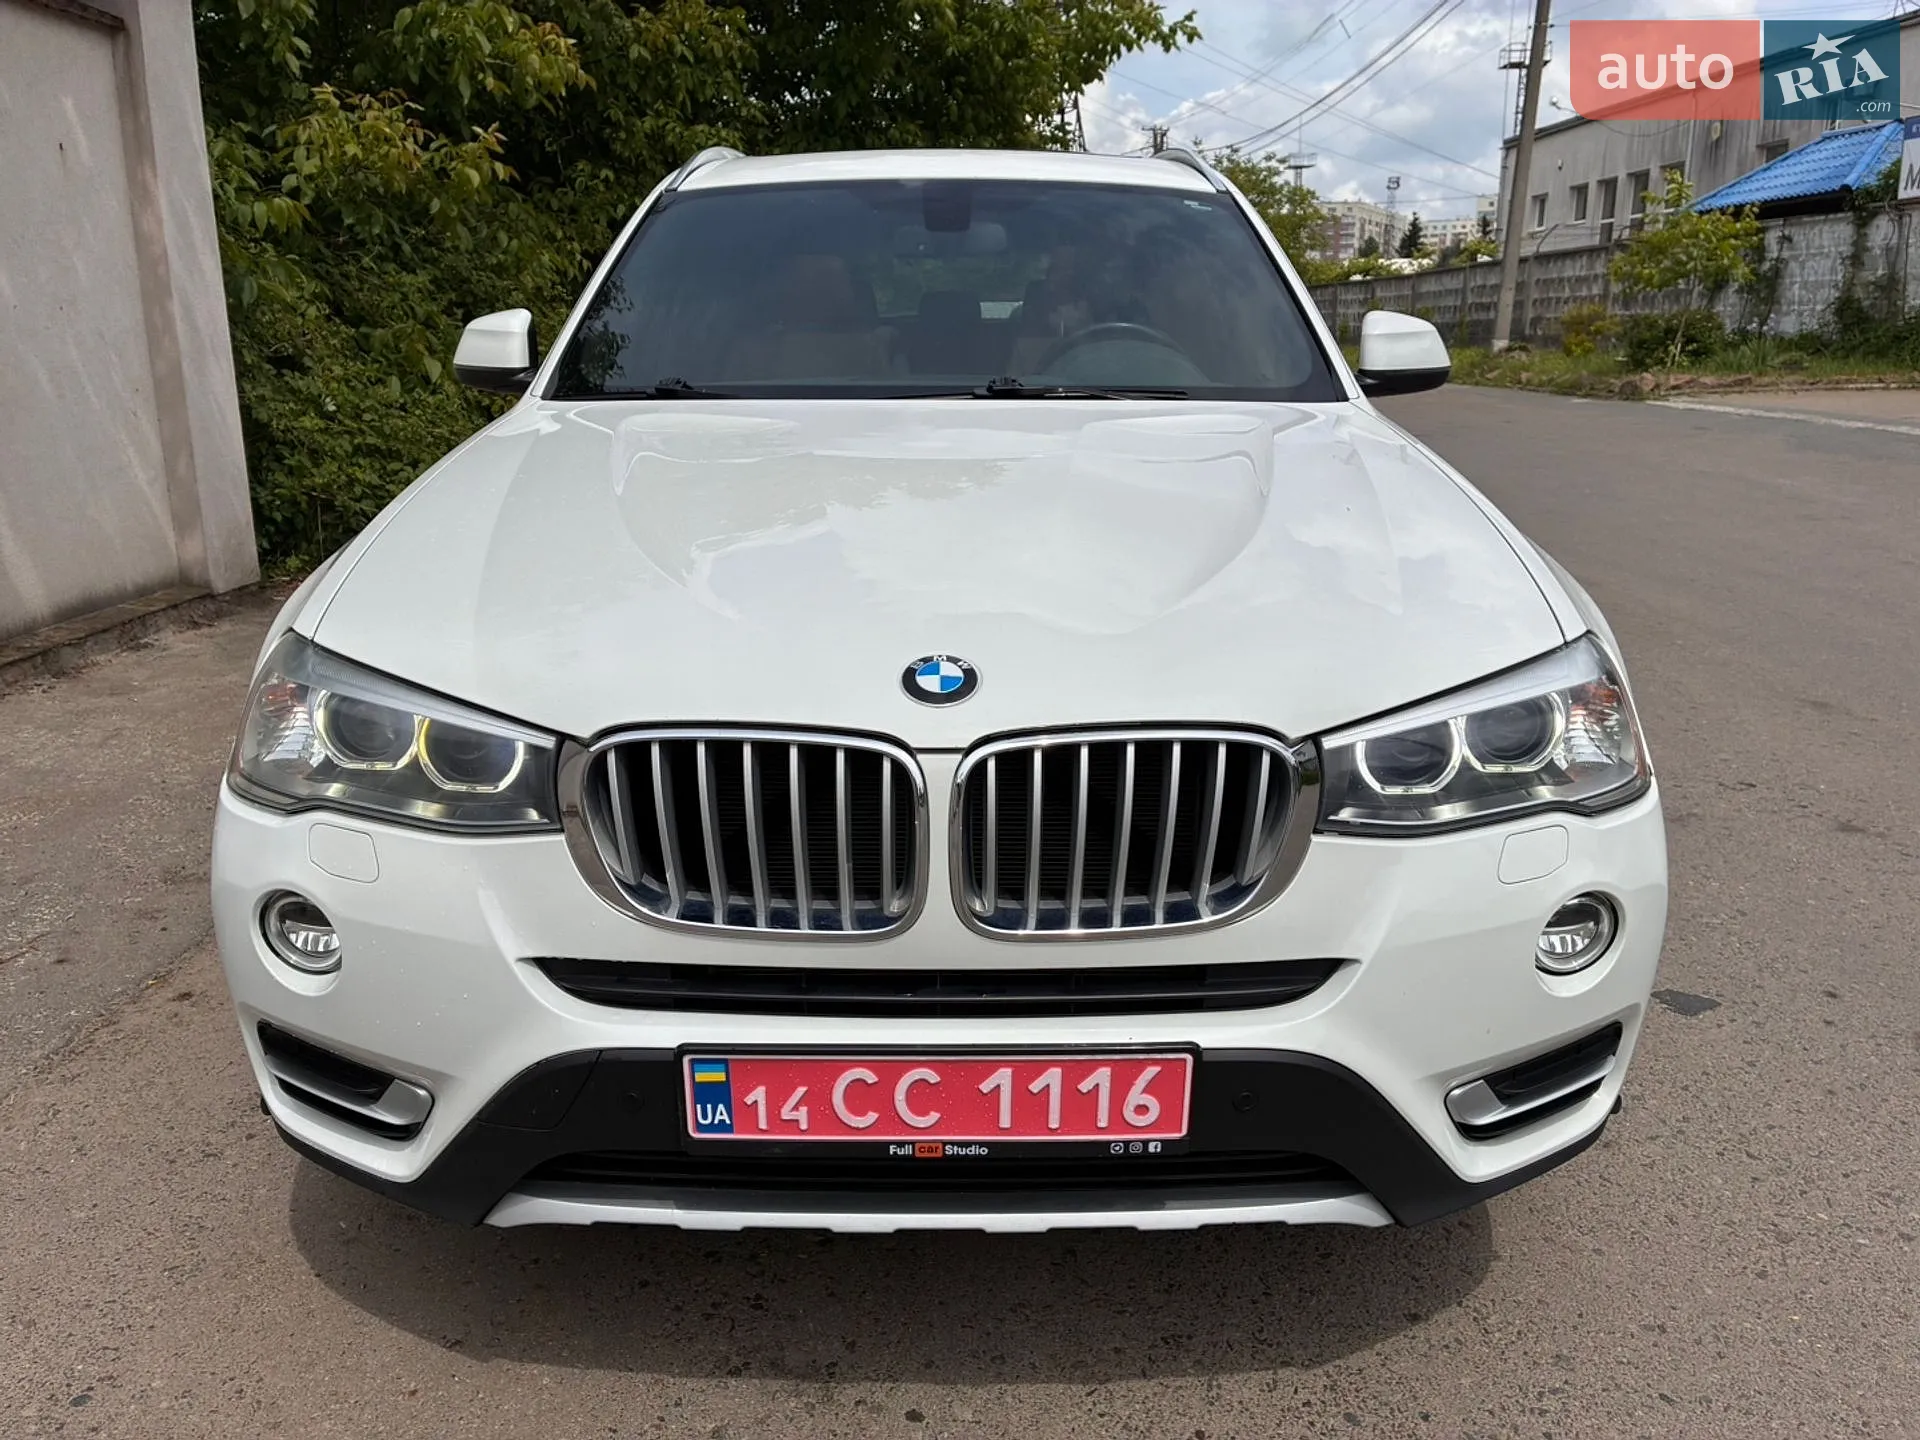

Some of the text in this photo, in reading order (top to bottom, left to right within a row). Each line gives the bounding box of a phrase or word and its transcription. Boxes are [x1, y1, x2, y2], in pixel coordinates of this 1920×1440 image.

[743, 1066, 1162, 1131] 14 CC 1116
[696, 1103, 731, 1125] UA
[889, 1144, 989, 1155] Full car Studio
